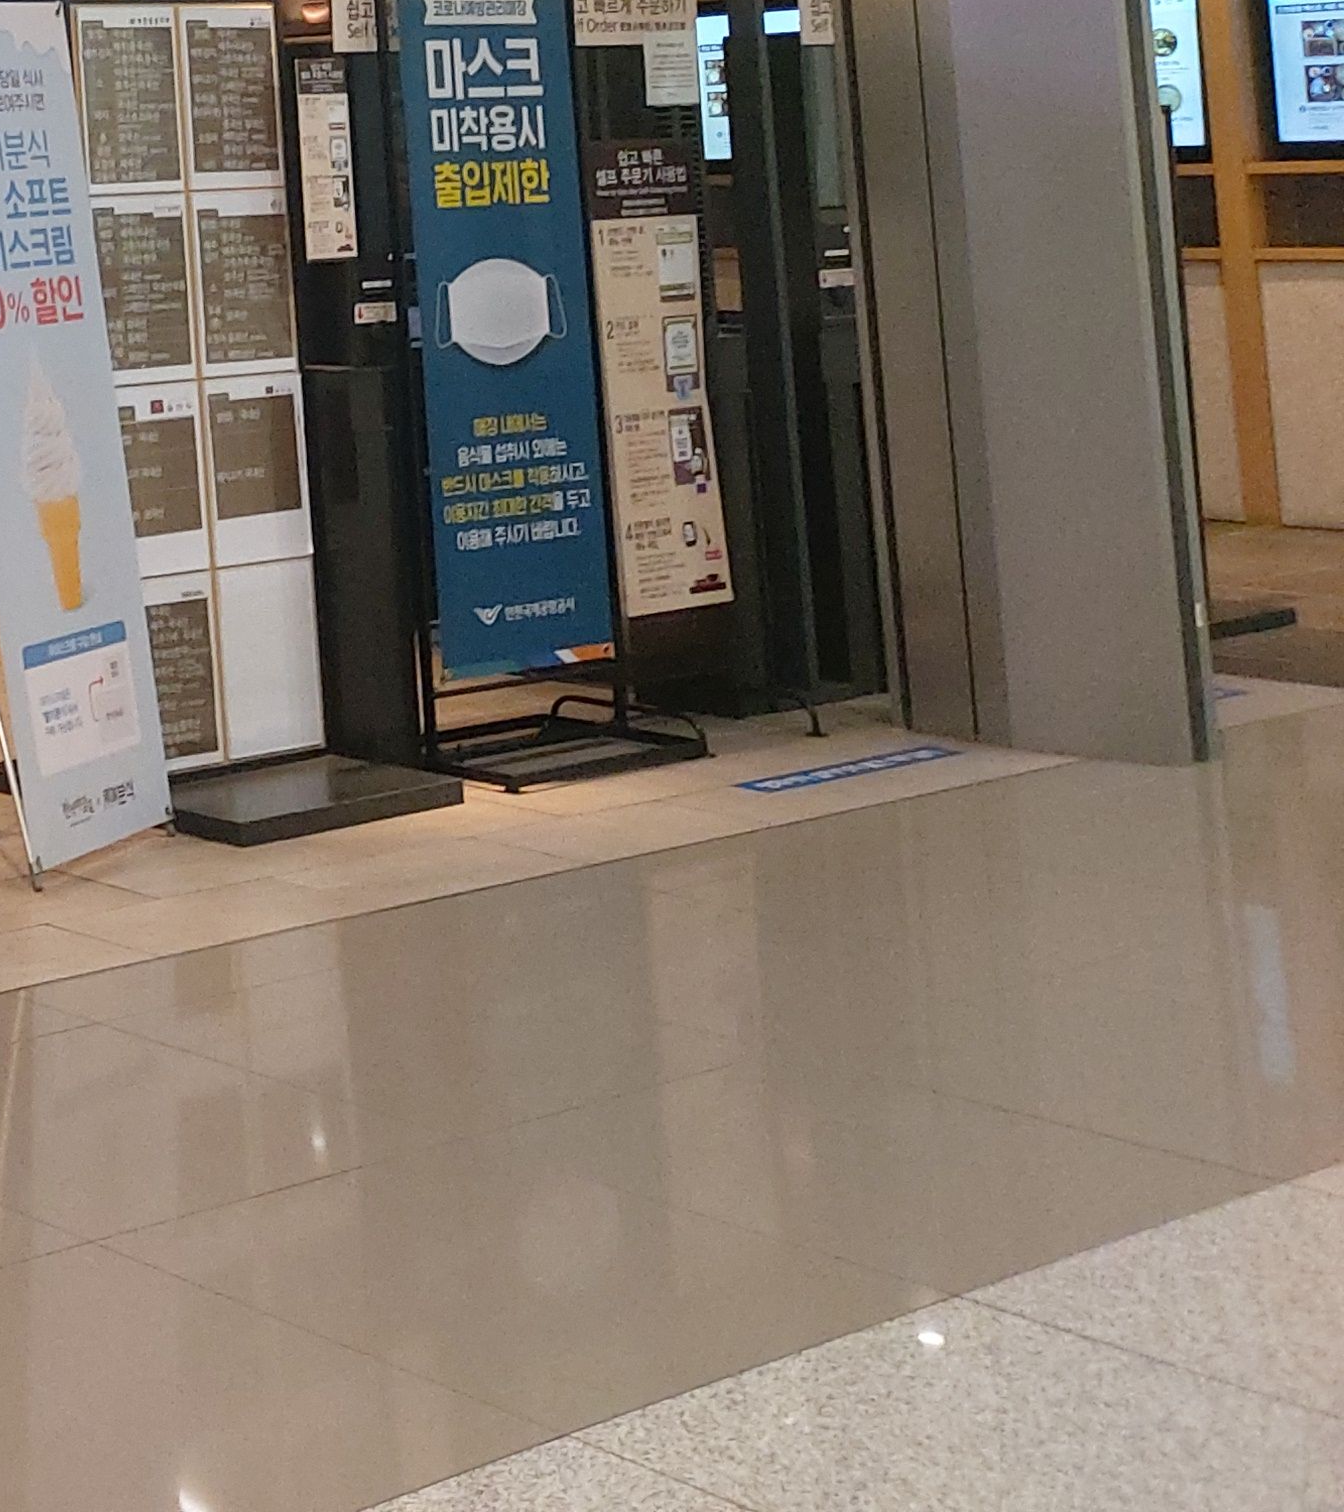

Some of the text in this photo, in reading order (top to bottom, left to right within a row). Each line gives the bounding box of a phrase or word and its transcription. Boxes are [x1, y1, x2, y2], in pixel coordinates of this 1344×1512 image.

[424, 38, 544, 100] 마스크
[430, 105, 546, 152] 미착용시
[4, 178, 72, 220] 소프트
[434, 158, 551, 208] 출입제한
[30, 274, 84, 326] 할인
[566, 489, 592, 509] 두고
